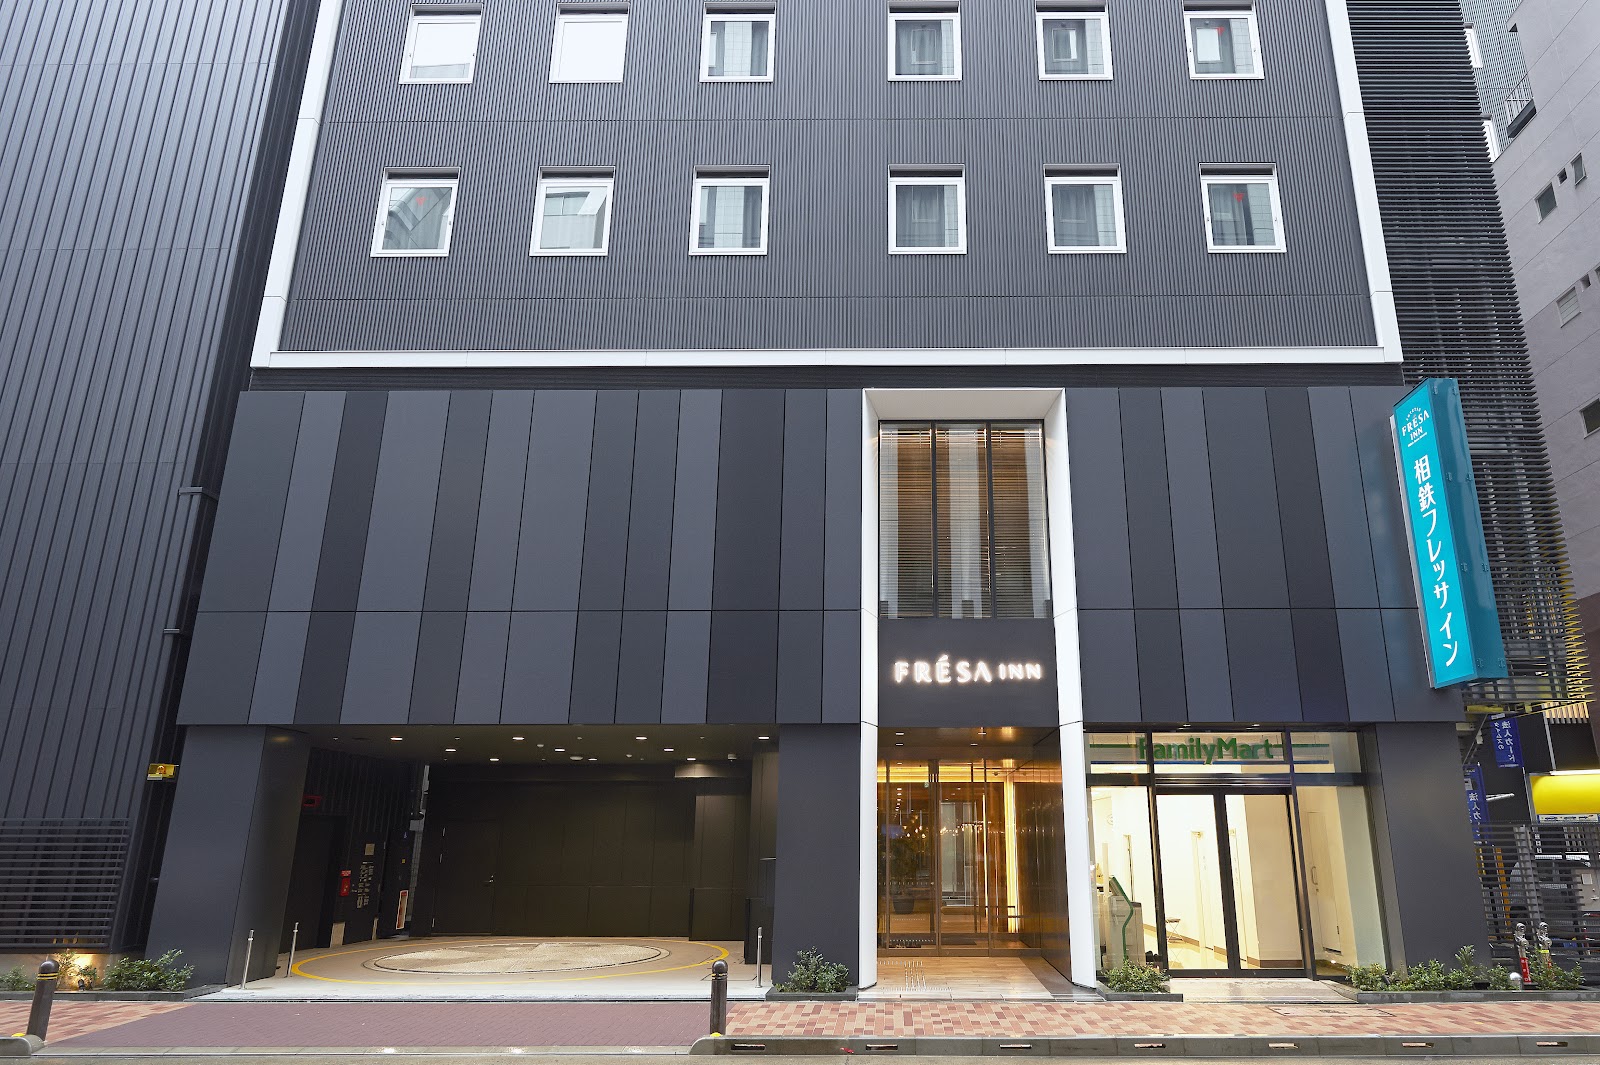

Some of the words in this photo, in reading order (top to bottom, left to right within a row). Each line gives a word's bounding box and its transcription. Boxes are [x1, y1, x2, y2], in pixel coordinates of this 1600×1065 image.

[1410, 426, 1424, 441] INN
[1413, 454, 1459, 668] 相鉄フレッサイン
[893, 653, 993, 684] FRÉSA
[998, 662, 1042, 681] INN
